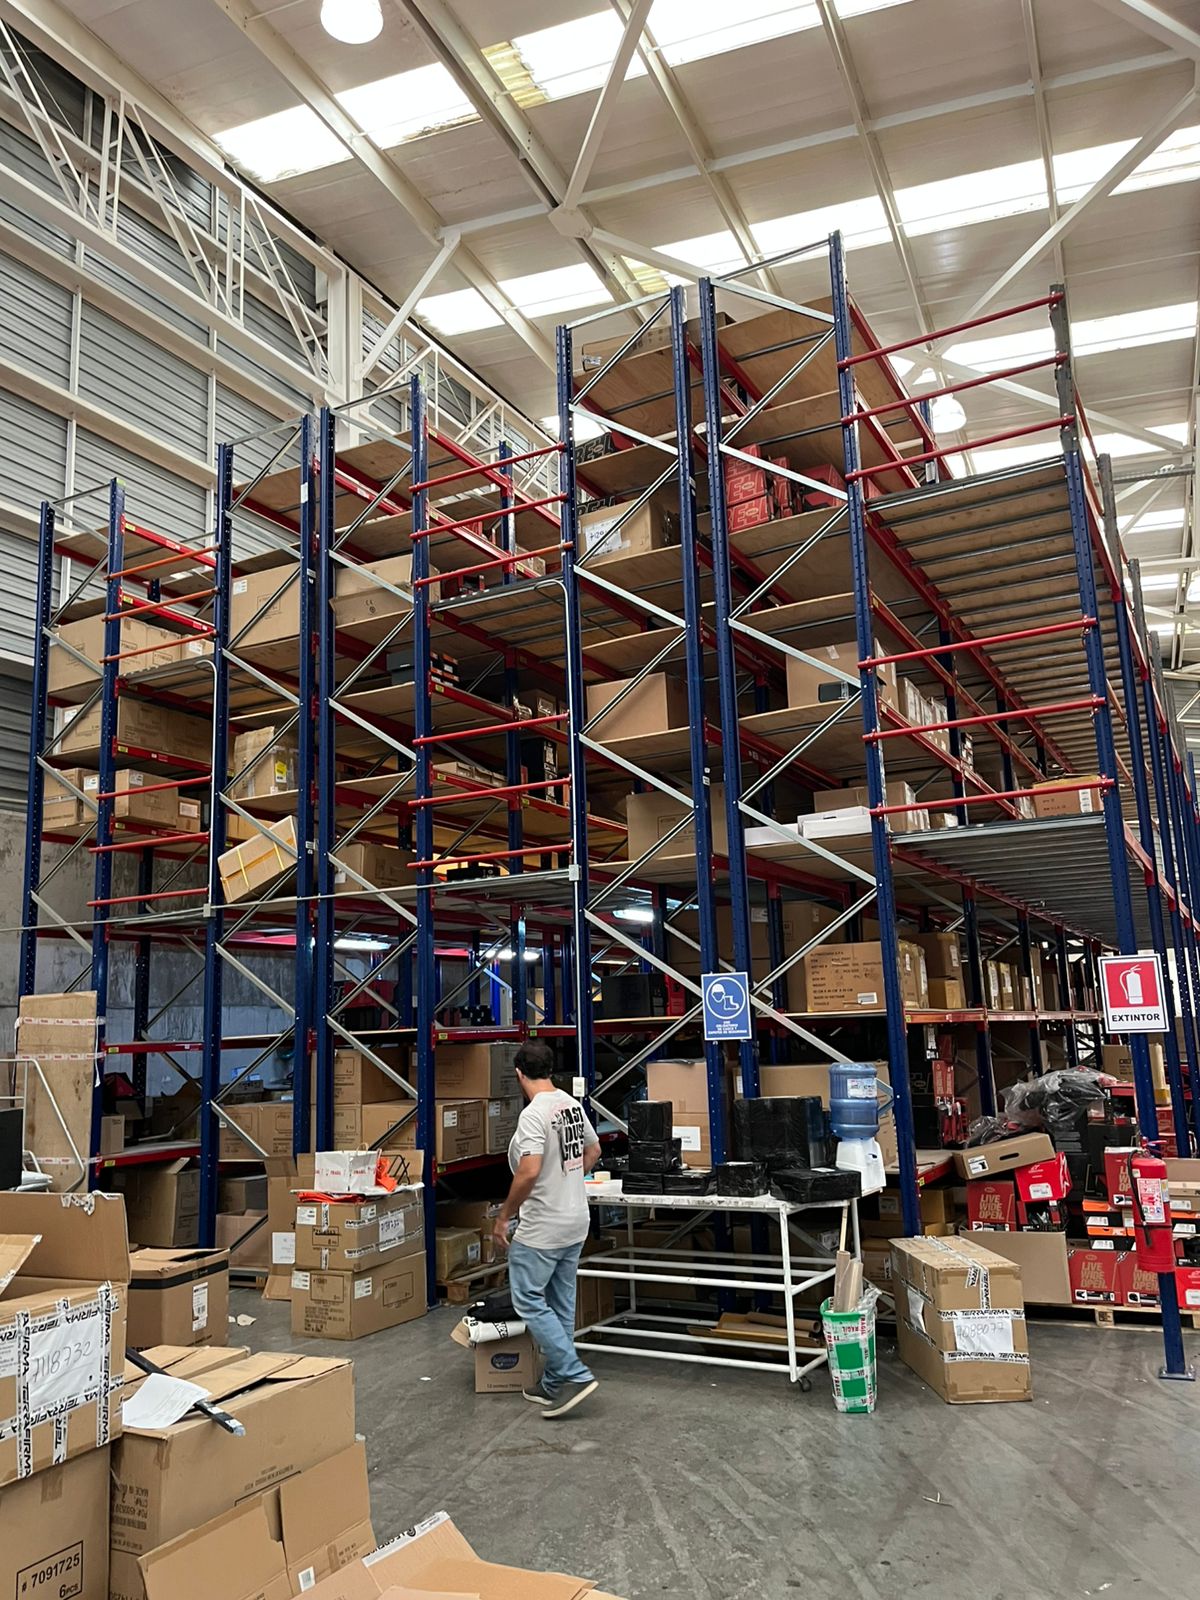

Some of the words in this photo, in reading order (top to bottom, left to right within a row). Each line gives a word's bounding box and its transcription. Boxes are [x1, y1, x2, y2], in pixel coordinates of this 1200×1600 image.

[1111, 1013, 1160, 1022] EXTINTOR
[562, 1141, 583, 1161] CYCL
[981, 1194, 1000, 1202] LIVE
[979, 1202, 1002, 1210] WIDE
[1082, 1262, 1103, 1271] LIVE
[1081, 1271, 1104, 1280] WIDE
[102, 1352, 111, 1443] TERRAFIRMA
[30, 1398, 79, 1427] TERRAFIR
[22, 1382, 32, 1477] TERRAFIRMA
[31, 1552, 80, 1589] 7091725
